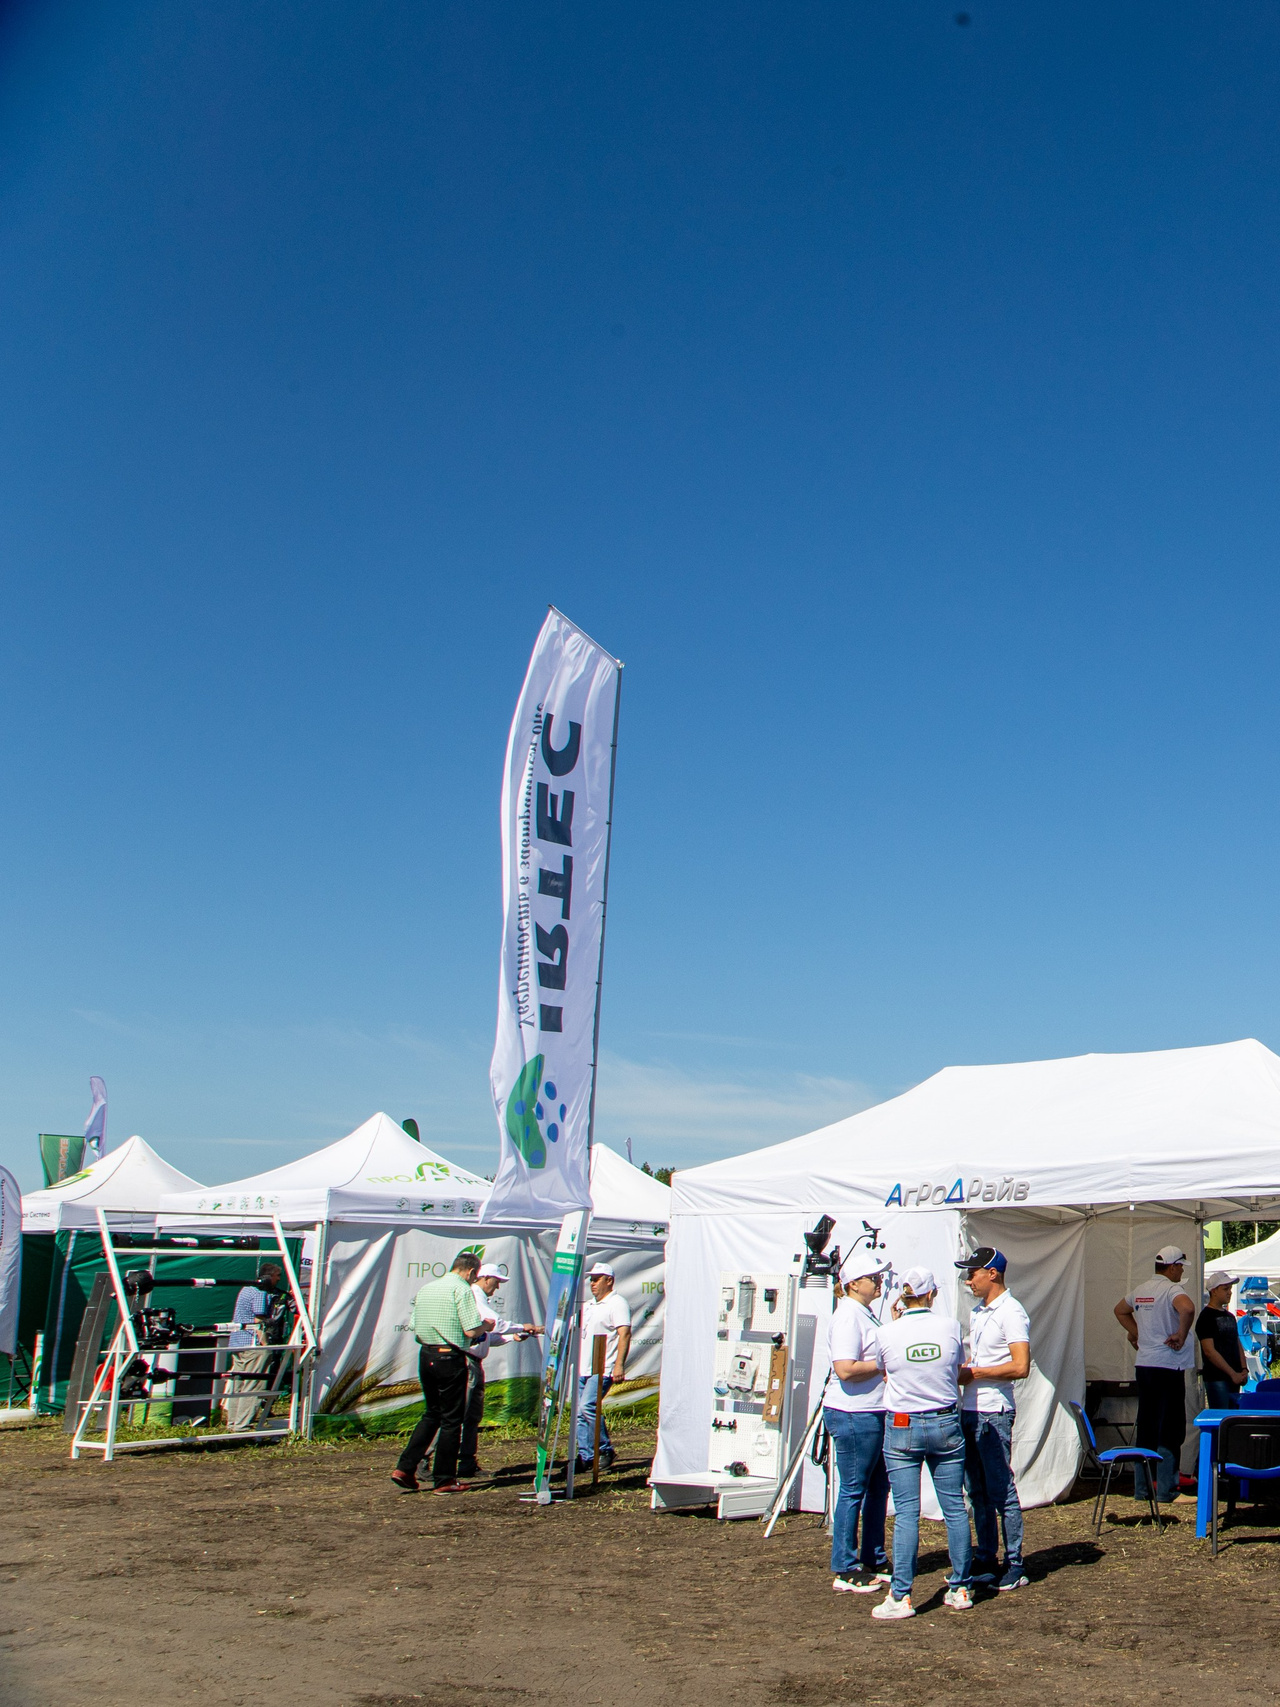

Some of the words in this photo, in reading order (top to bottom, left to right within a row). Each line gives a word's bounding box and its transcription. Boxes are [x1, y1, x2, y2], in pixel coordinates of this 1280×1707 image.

[407, 1262, 447, 1278] ПРО
[641, 1282, 665, 1294] ПРО
[630, 1337, 664, 1345] ПРОФЕССИО
